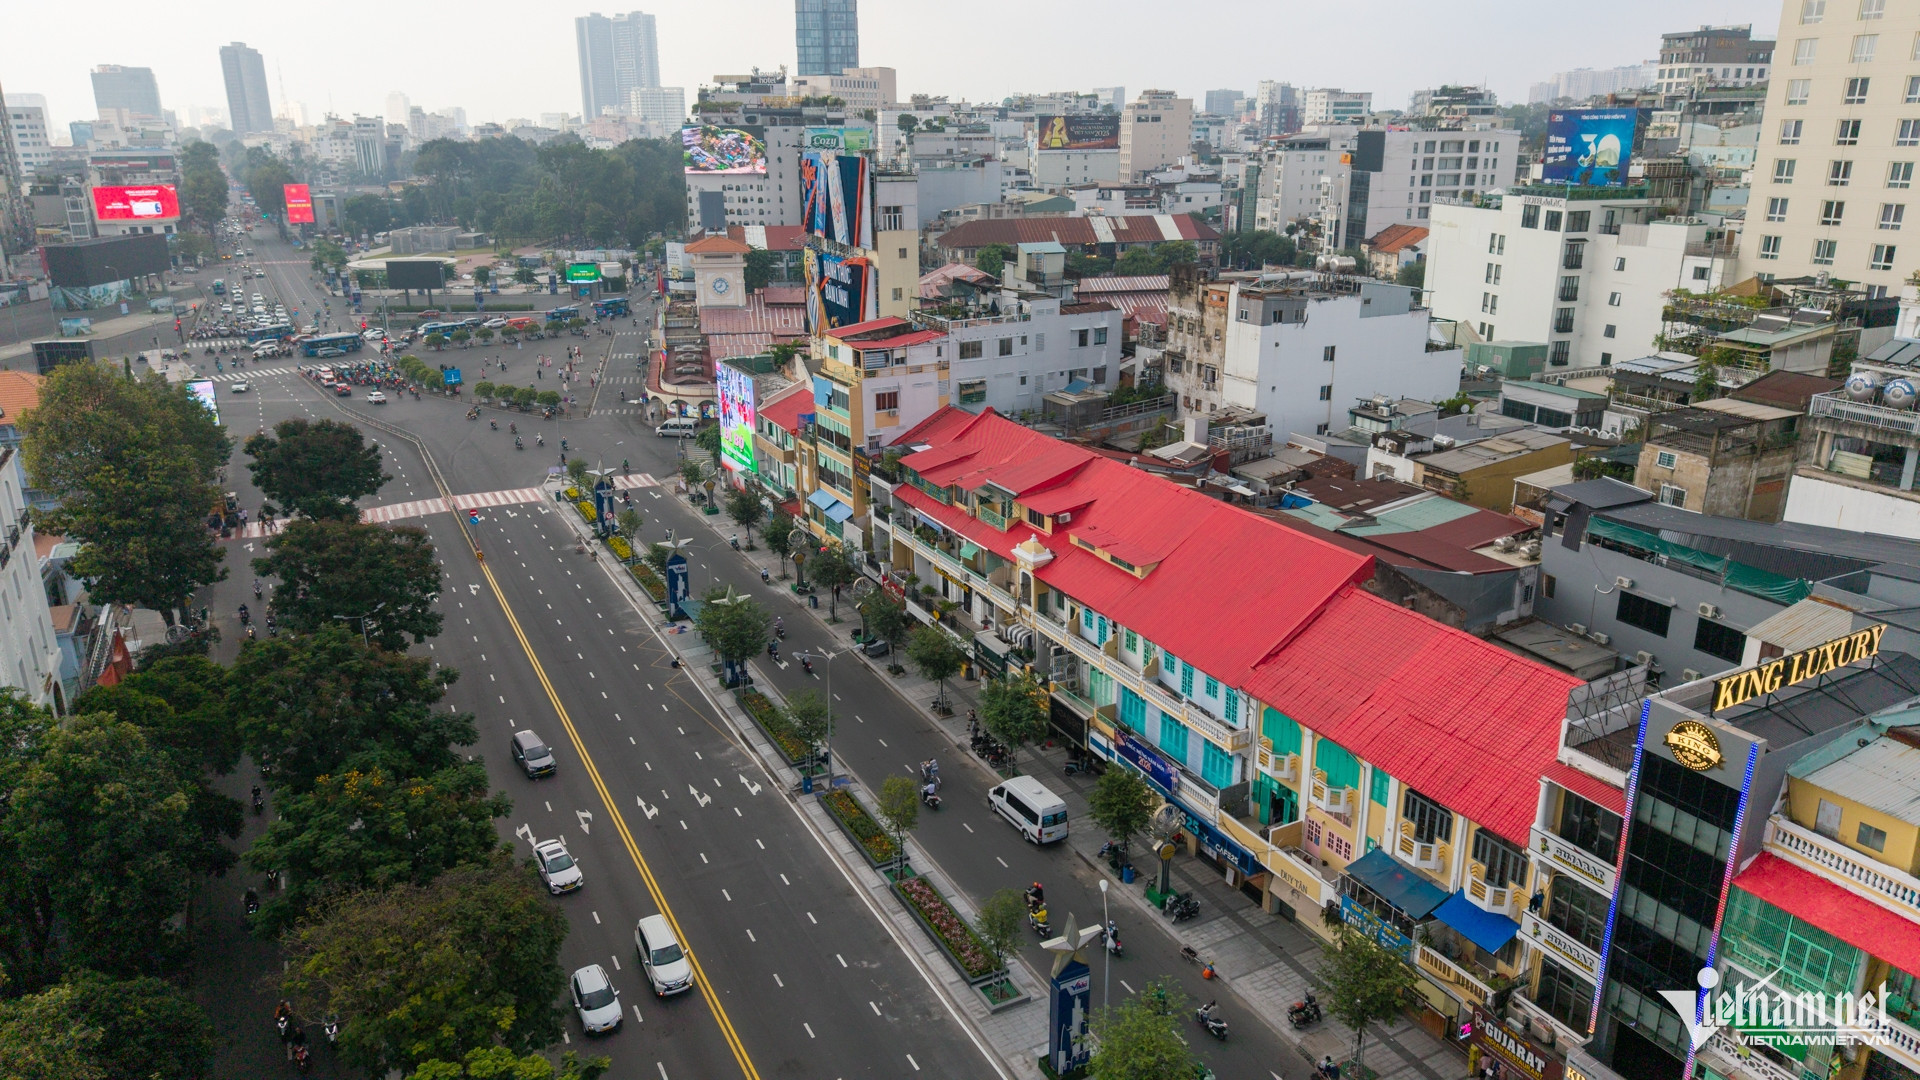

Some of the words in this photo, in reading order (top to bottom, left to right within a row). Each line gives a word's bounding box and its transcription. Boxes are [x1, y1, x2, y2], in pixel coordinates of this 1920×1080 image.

[813, 136, 837, 147] Cozy
[1714, 659, 1786, 713] KING
[1787, 623, 1888, 687] LUXURY
[1678, 736, 1710, 755] KING
[1215, 844, 1239, 865] CAFE25
[1555, 846, 1606, 880] GUJARAT
[1280, 869, 1296, 886] DUY
[1295, 878, 1308, 895] TÂN
[1547, 931, 1595, 967] GUJARAT
[1484, 1035, 1505, 1053] INDIAN
[1504, 1048, 1543, 1080] RESTAURANT
[1485, 1021, 1546, 1074] GUJARAT
